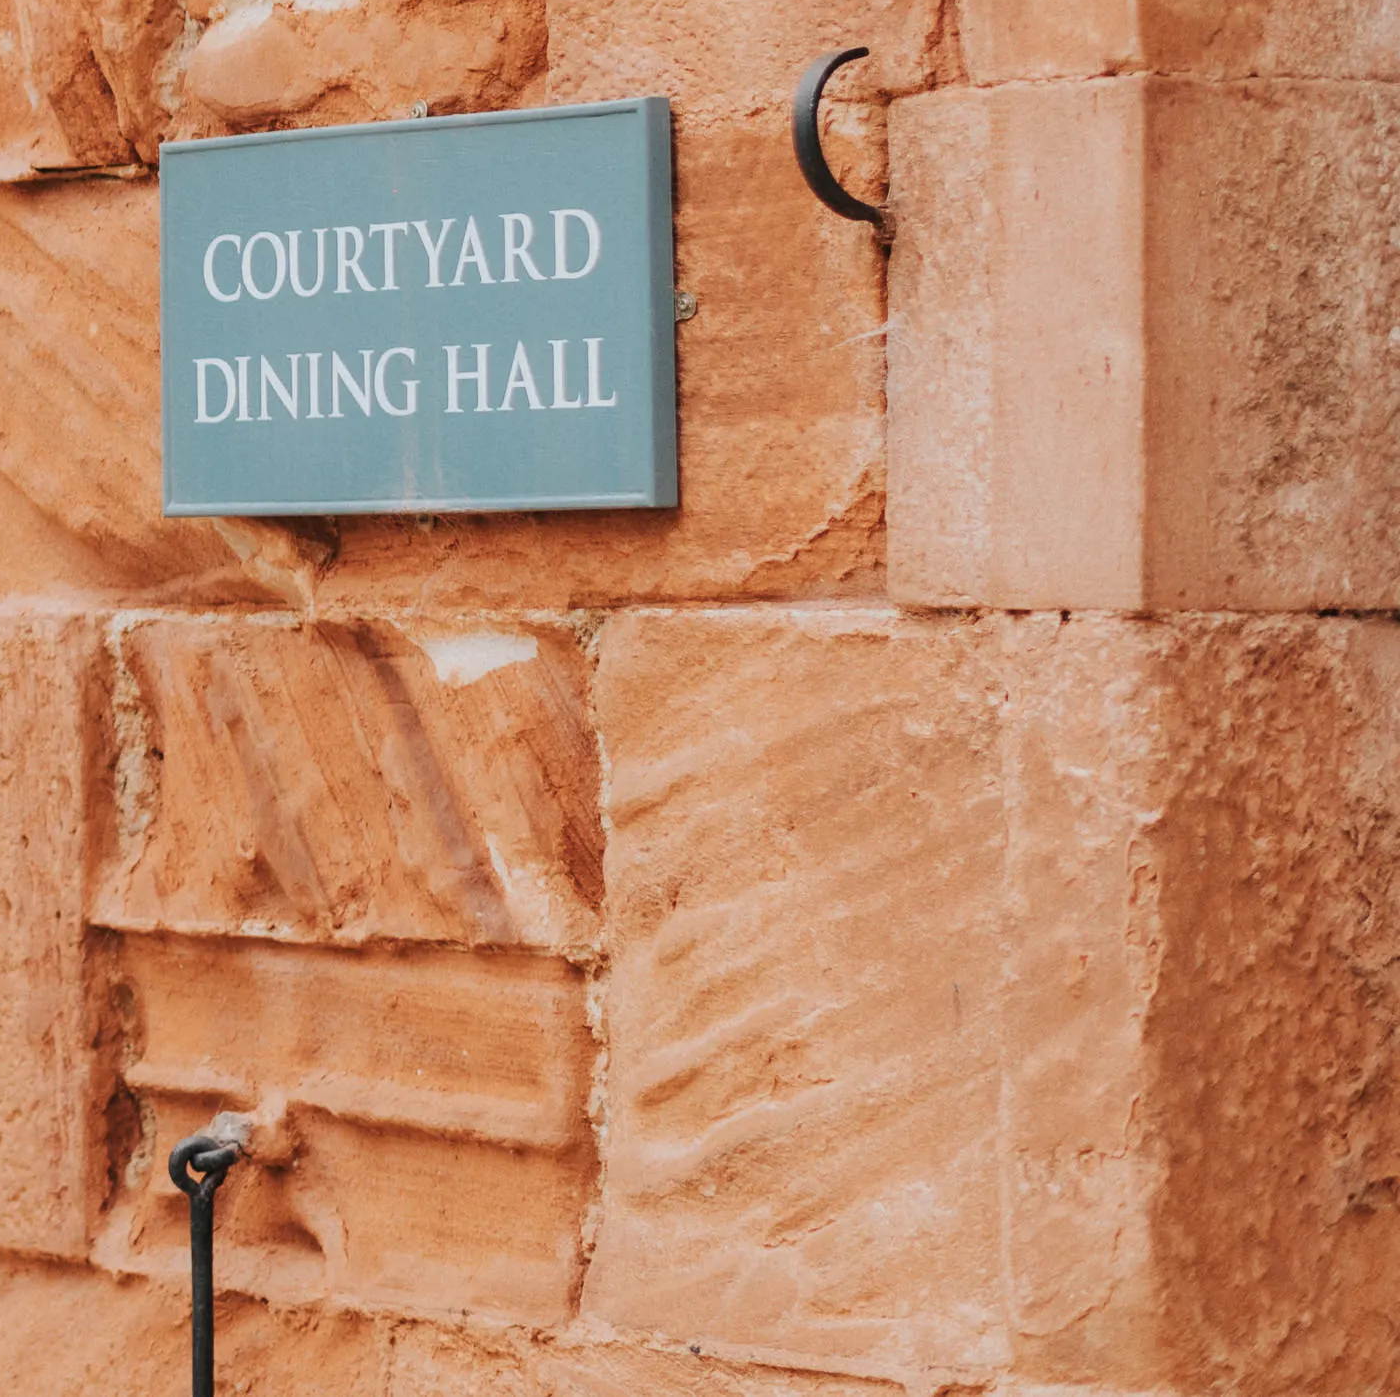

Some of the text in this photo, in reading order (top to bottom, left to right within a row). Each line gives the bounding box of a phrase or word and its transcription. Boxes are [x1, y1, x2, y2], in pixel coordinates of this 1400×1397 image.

[203, 208, 601, 302] COURTYARD
[192, 337, 617, 424] DINING HALL
